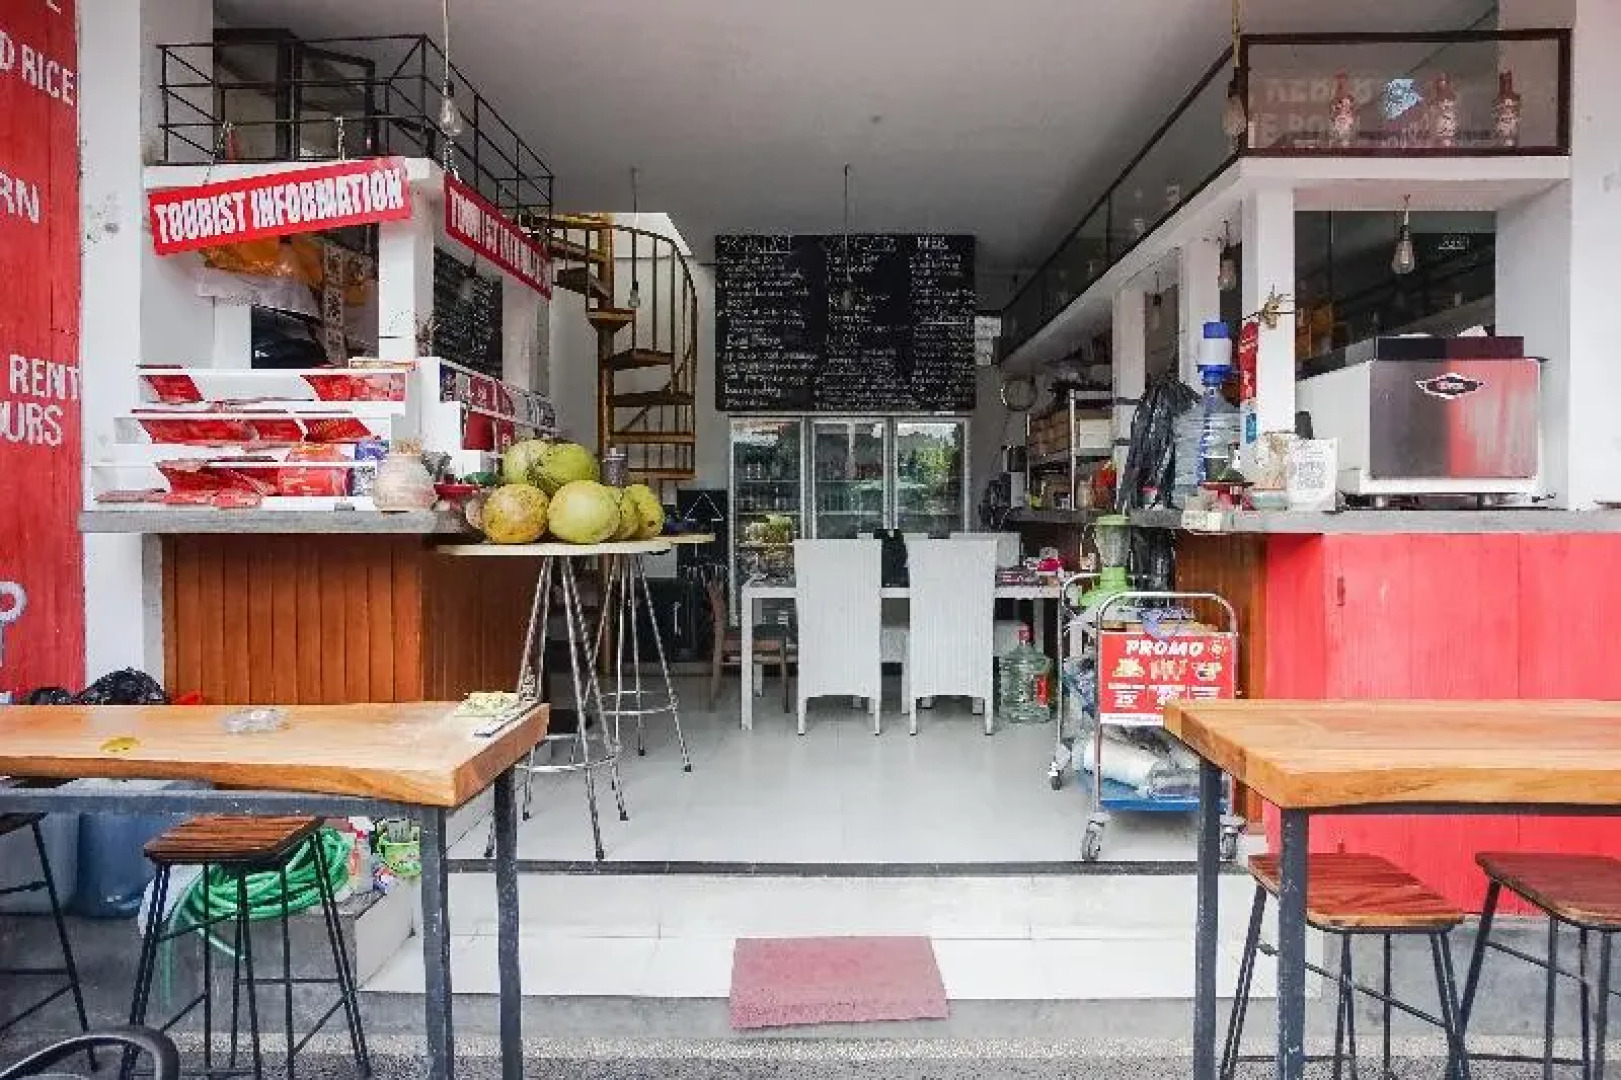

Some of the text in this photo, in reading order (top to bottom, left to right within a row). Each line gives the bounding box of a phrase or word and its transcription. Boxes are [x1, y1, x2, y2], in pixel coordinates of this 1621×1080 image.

[21, 44, 74, 106] RICE
[251, 168, 404, 230] INFORMATION
[9, 354, 80, 400] RENT
[1126, 639, 1205, 657] PROMO
